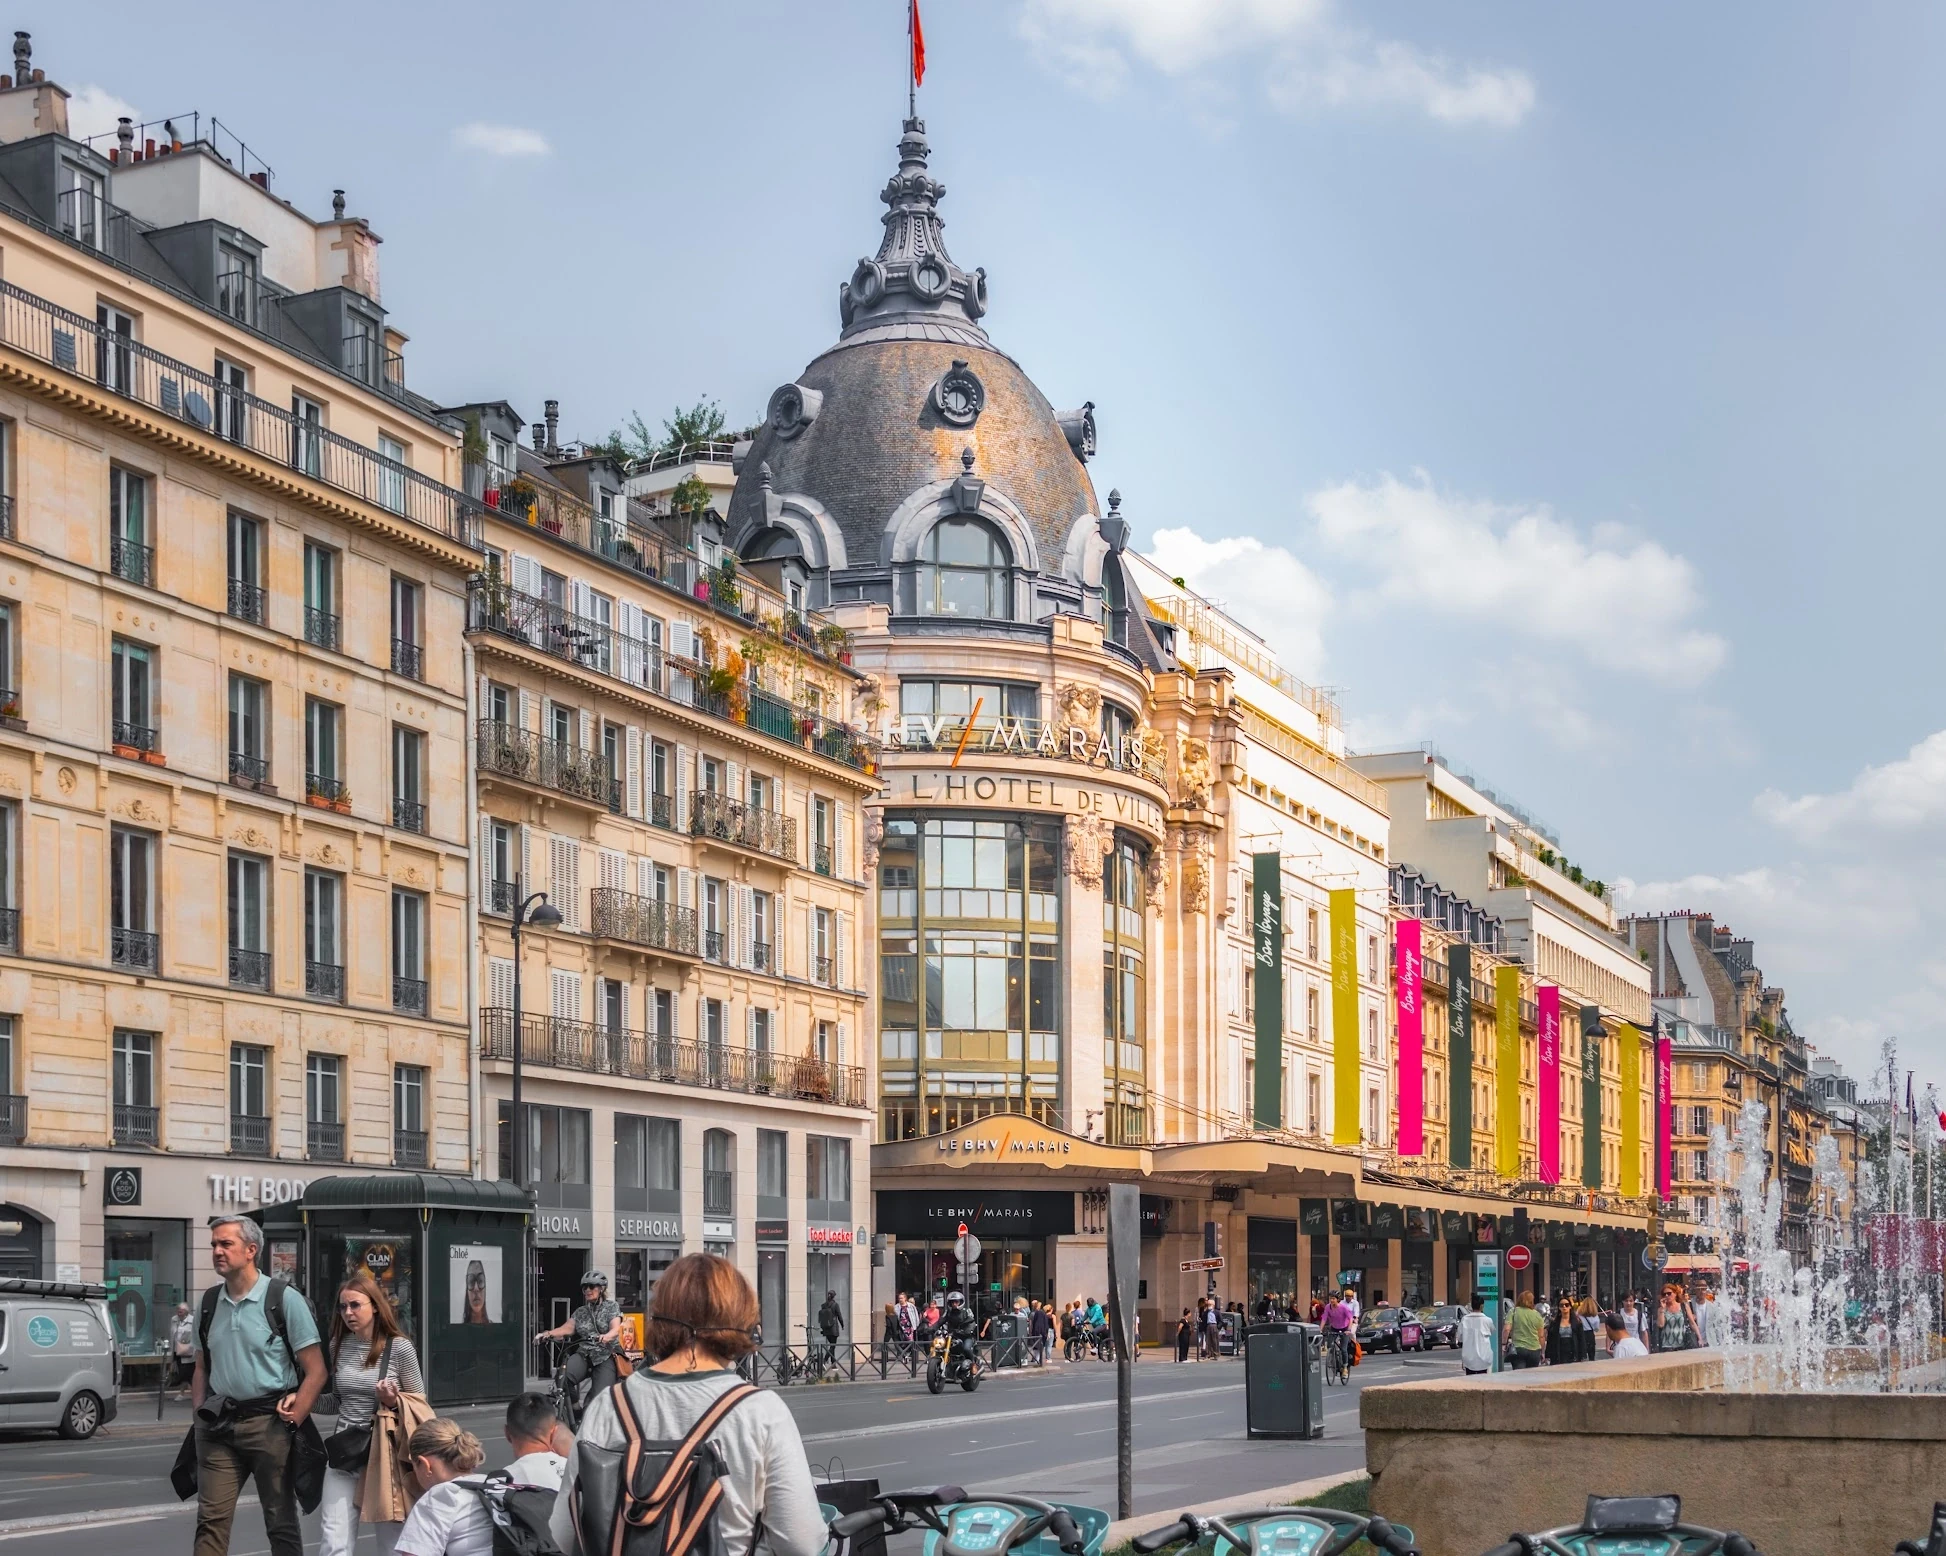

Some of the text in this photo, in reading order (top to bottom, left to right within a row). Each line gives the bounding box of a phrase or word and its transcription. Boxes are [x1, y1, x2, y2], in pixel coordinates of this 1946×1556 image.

[990, 718, 1143, 769] MARAIS
[1078, 790, 1103, 813] DE
[1114, 792, 1161, 832] VILLE
[1255, 891, 1280, 967] Bon Voyage
[1333, 925, 1354, 994] Bon Voyage
[1400, 948, 1419, 1014] Bon Voyage
[1450, 977, 1470, 1037] Bon Voyage
[1499, 1034, 1511, 1052] Bon
[1540, 1012, 1558, 1066] Bon Voyage
[1583, 1062, 1595, 1082] Bon
[939, 1140, 957, 1150] LE
[965, 1140, 998, 1150] BHV
[1012, 1141, 1071, 1152] MARAIS
[210, 1174, 254, 1202] THE
[928, 1208, 943, 1217] LE
[948, 1208, 974, 1217] BHV
[984, 1209, 1033, 1218] MARAIS
[536, 1216, 580, 1233] HORA
[620, 1219, 679, 1236] SEPHORA
[810, 1227, 826, 1242] Foot
[829, 1228, 853, 1243] Locker
[366, 1253, 390, 1262] CLAN
[450, 1246, 468, 1259] Chloé
